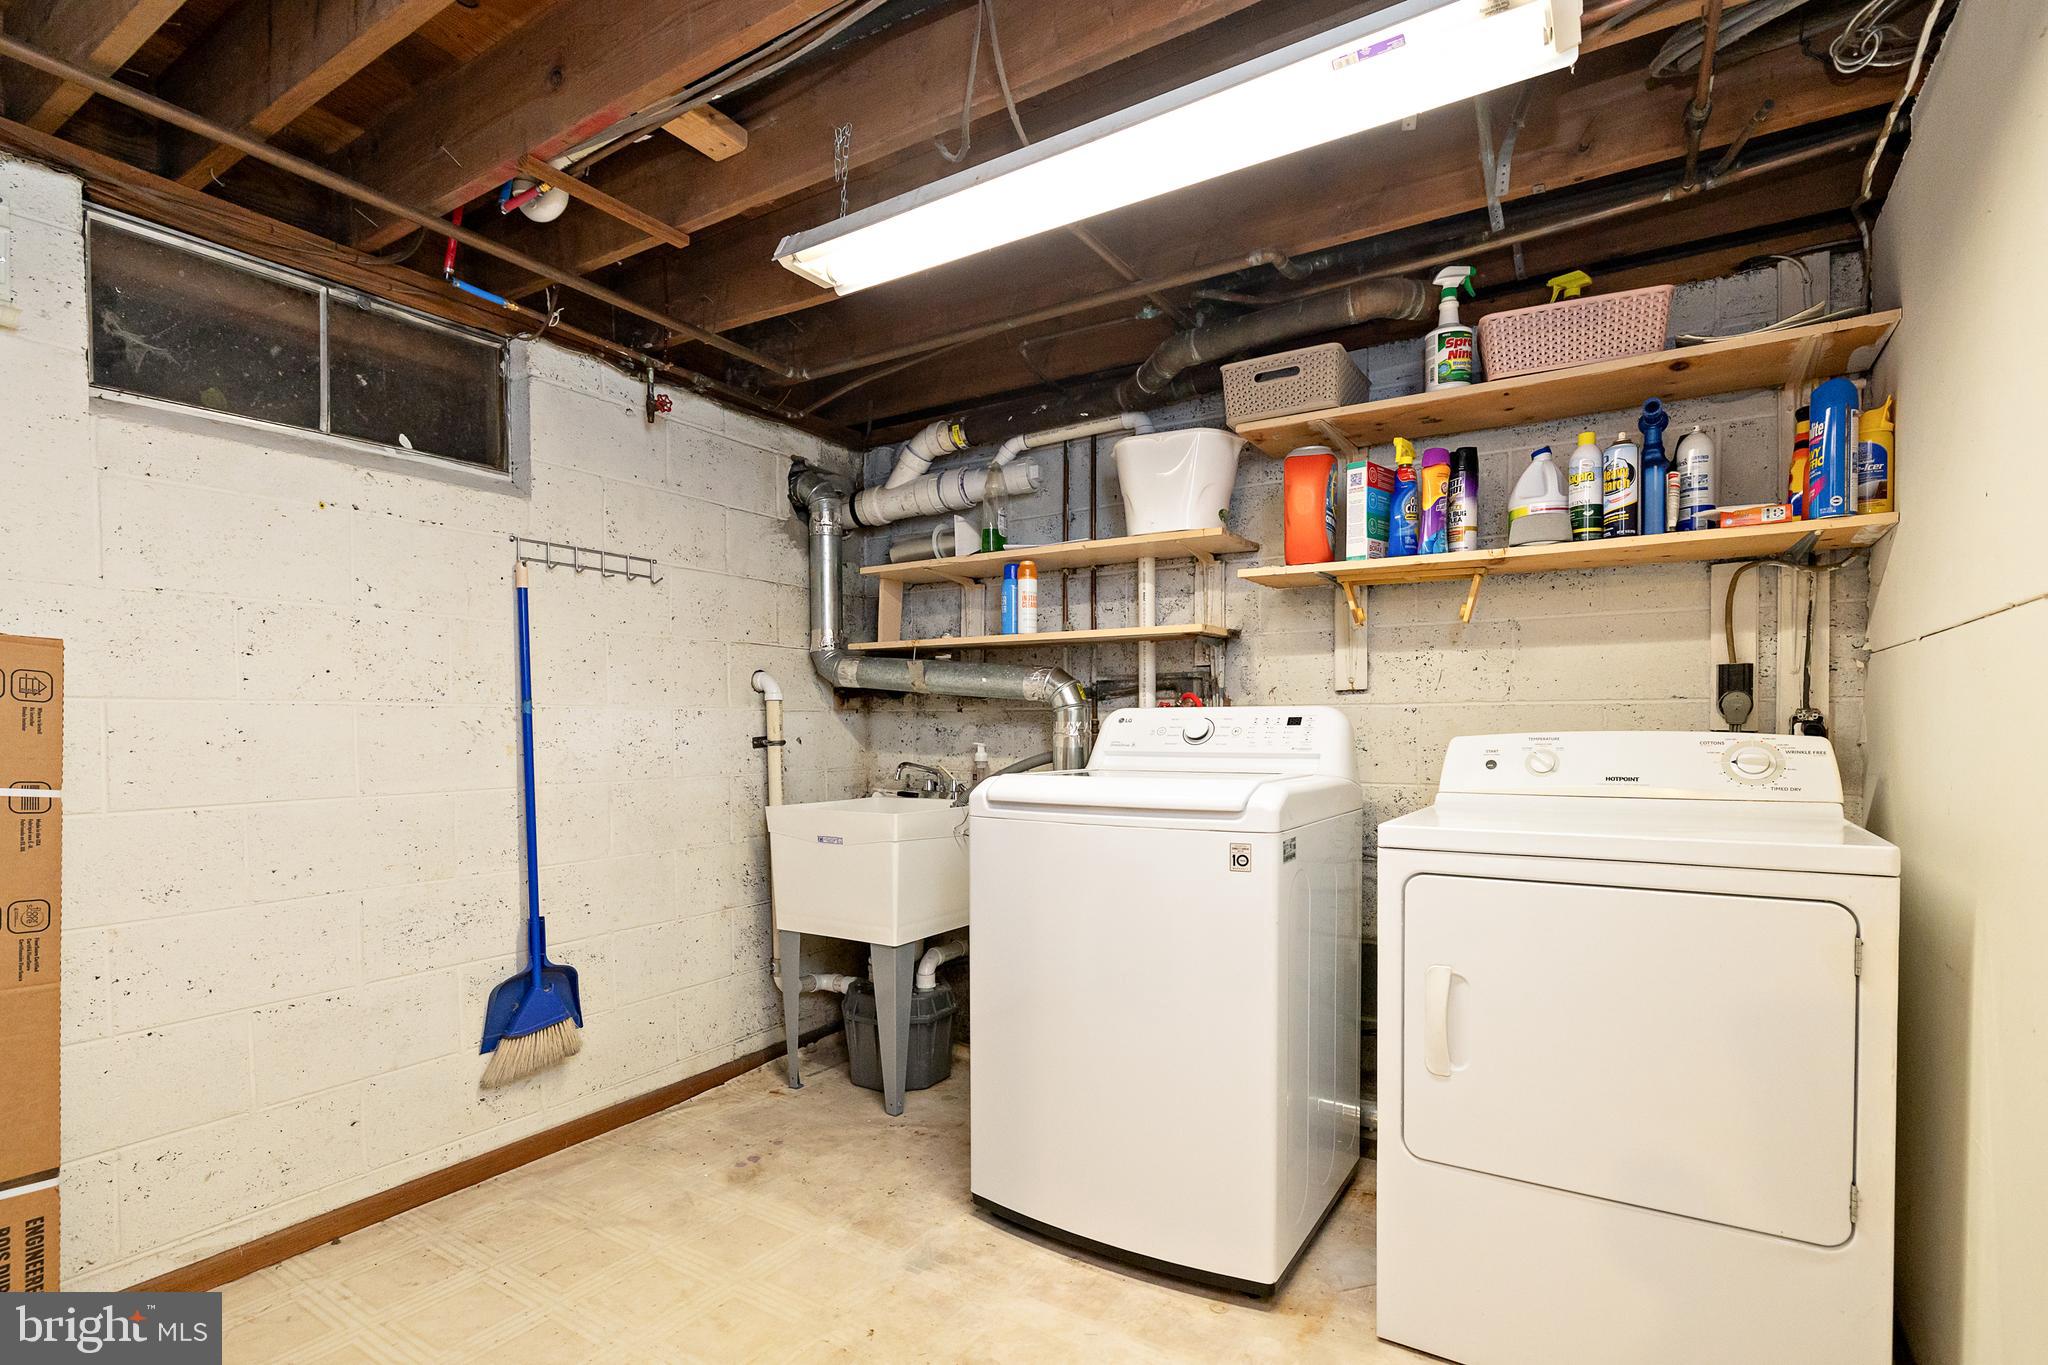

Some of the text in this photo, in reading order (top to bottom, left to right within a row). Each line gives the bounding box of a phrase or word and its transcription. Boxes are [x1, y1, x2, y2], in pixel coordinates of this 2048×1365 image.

[1232, 854, 1249, 867] 10
[32, 907, 42, 924] floor
[25, 1216, 45, 1292] ENGINEERE
